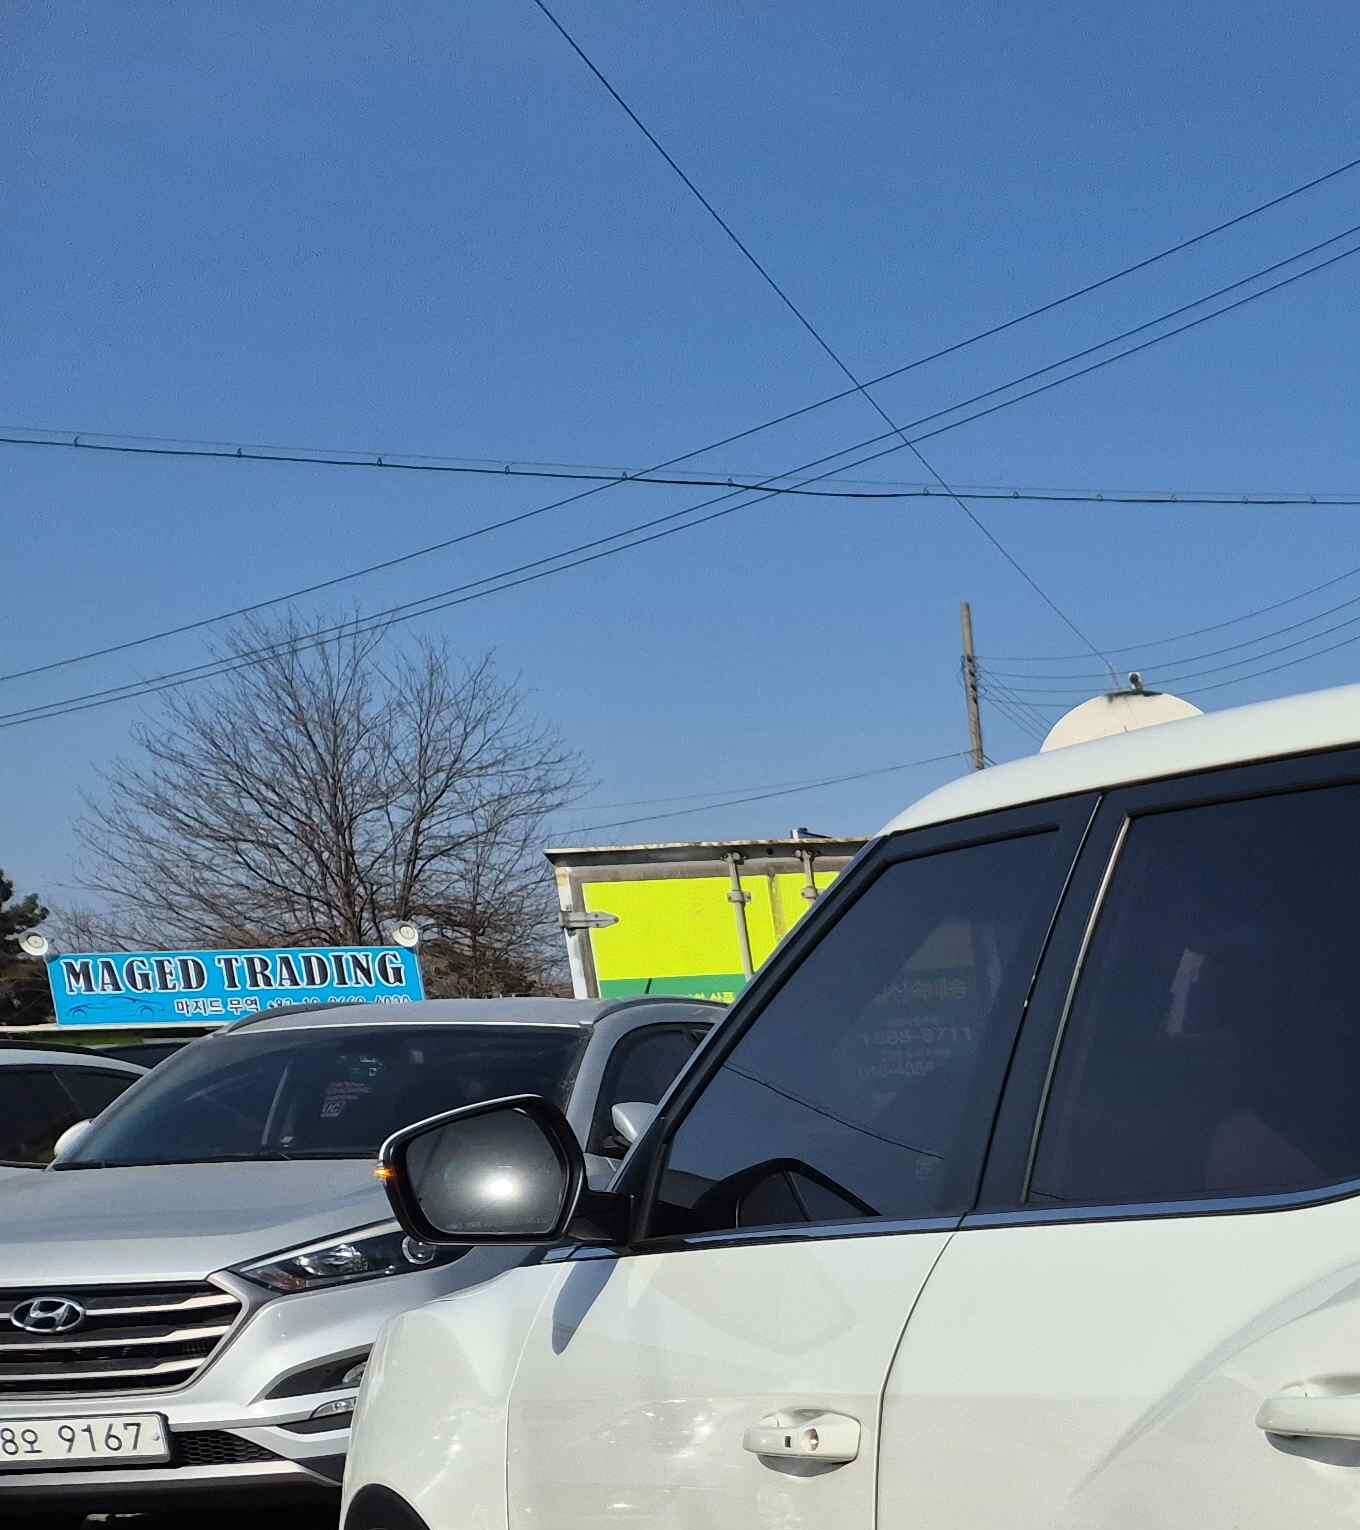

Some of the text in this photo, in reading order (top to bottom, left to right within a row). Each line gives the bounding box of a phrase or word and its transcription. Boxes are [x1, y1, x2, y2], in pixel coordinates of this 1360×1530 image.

[61, 950, 407, 996] MAGED TRADING
[175, 998, 225, 1016] 마지드
[227, 996, 261, 1015] 무역
[57, 1422, 141, 1453] 9167
